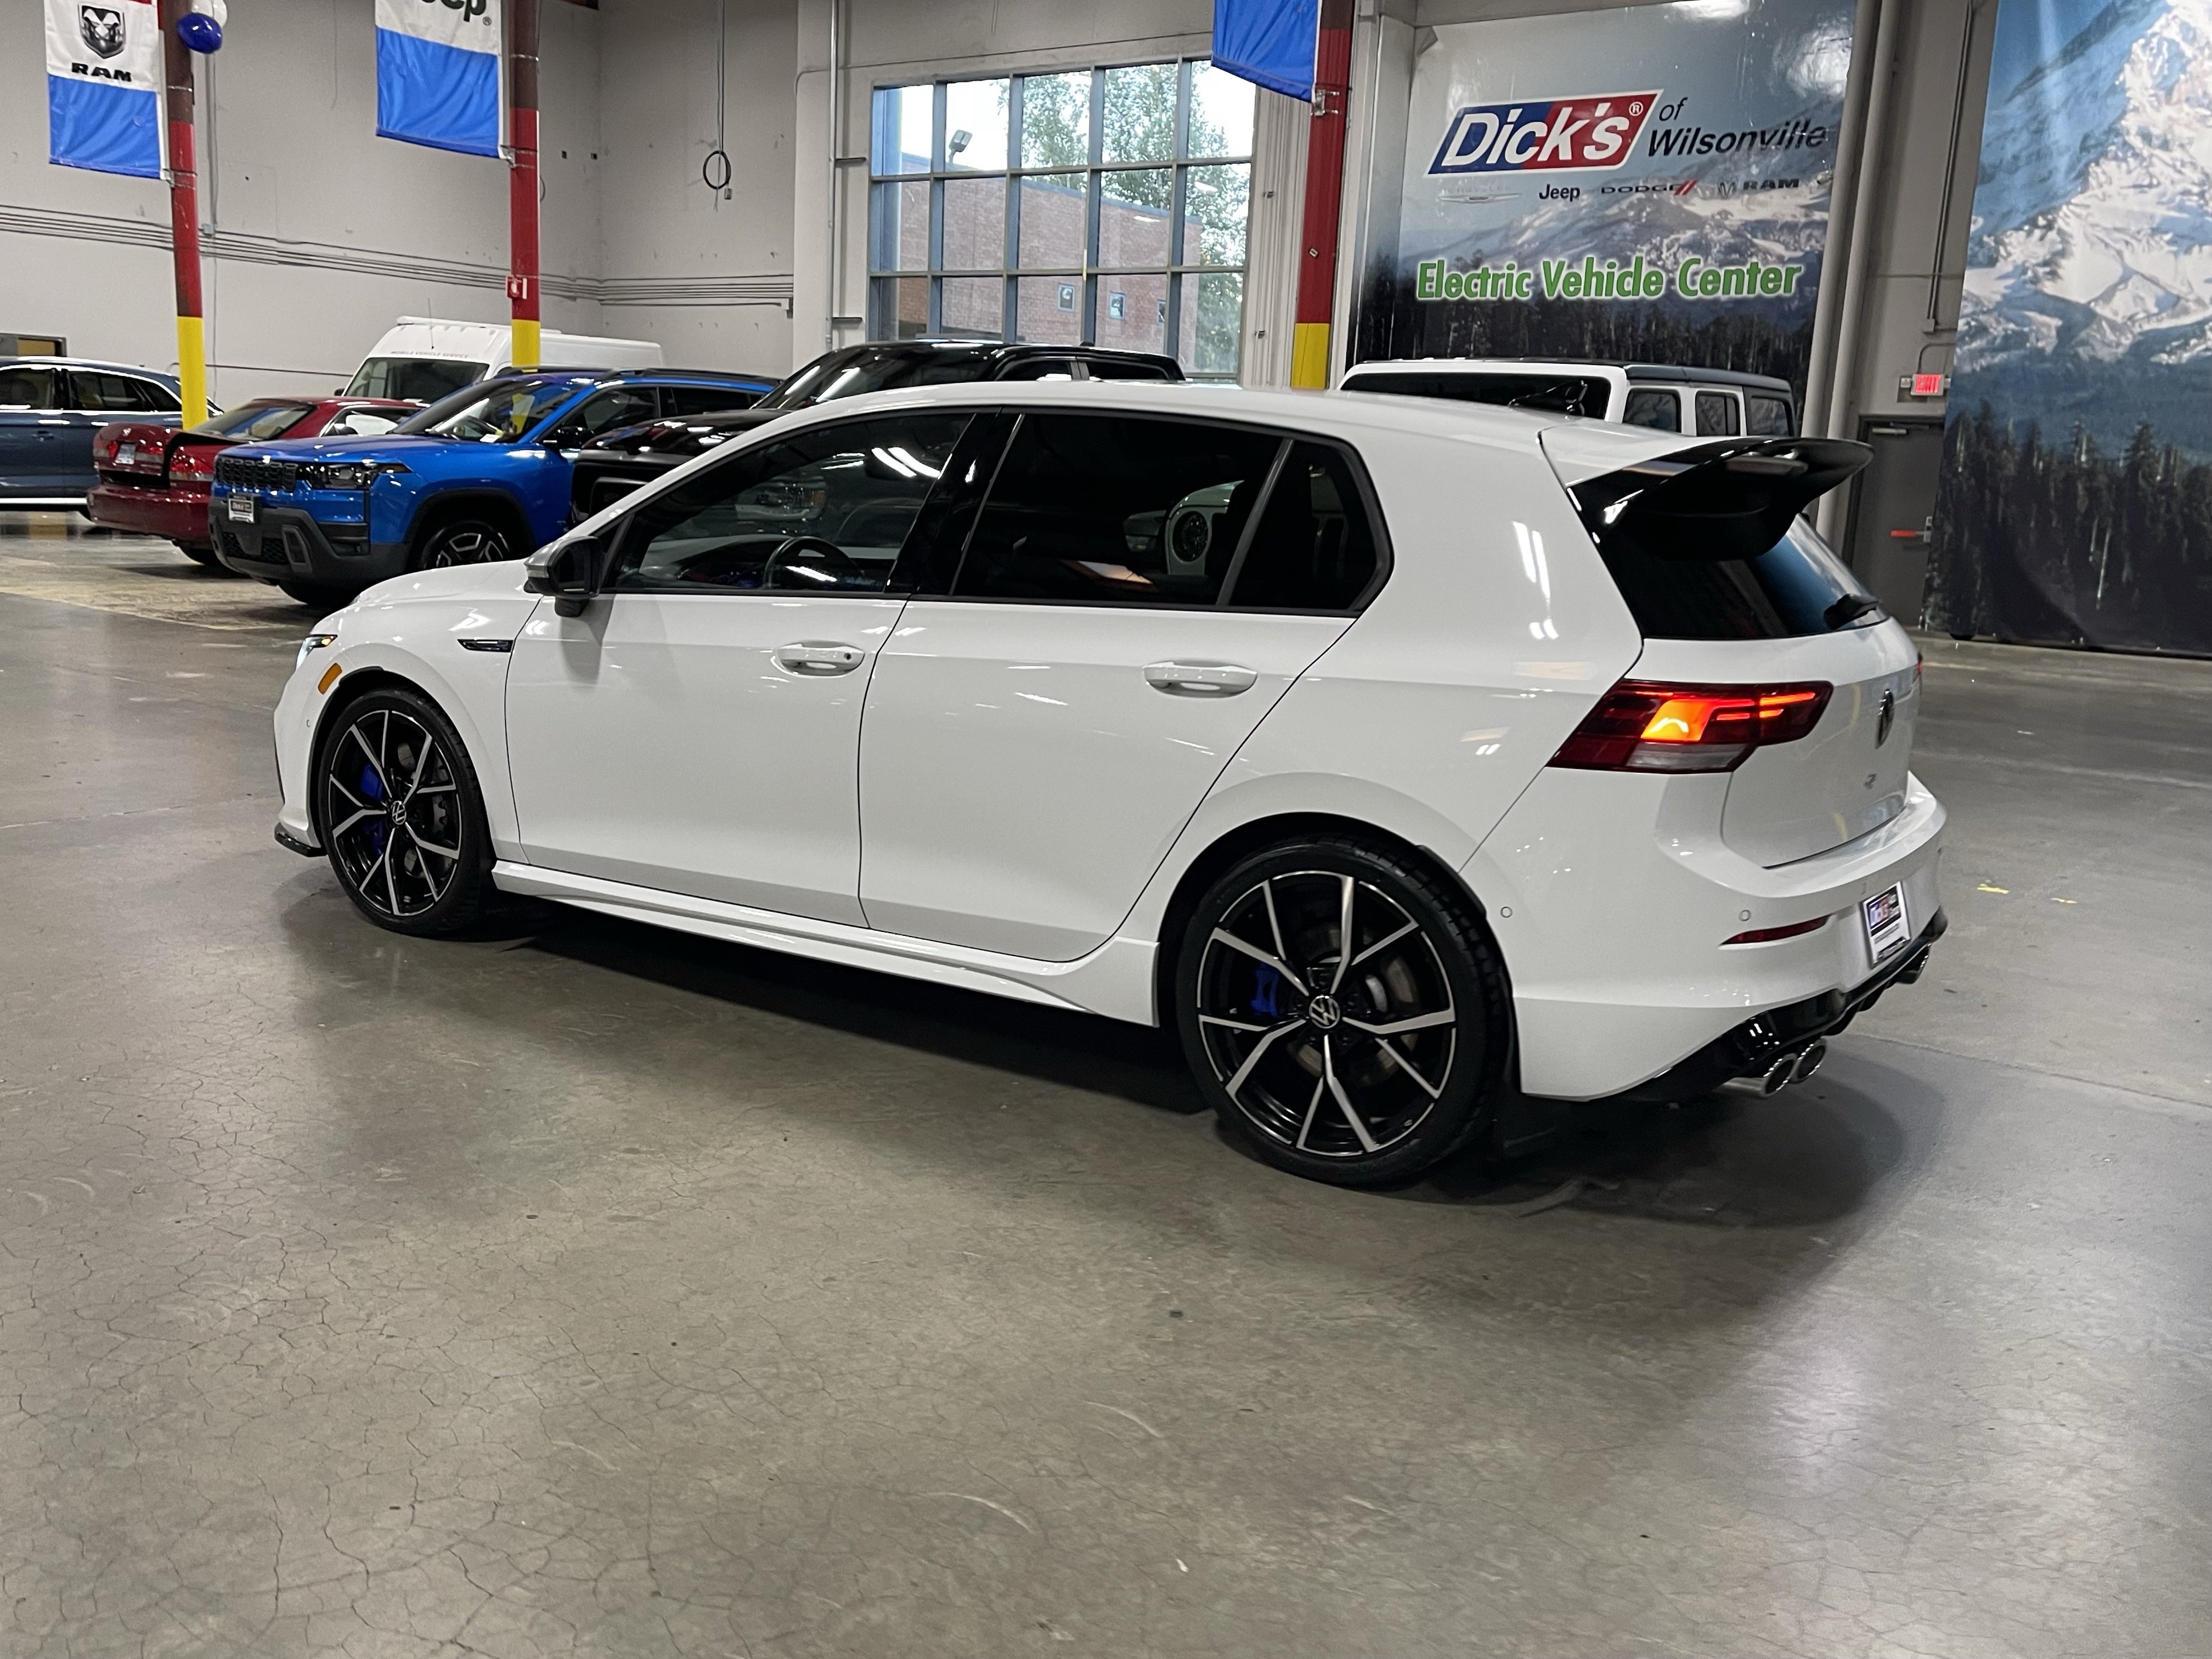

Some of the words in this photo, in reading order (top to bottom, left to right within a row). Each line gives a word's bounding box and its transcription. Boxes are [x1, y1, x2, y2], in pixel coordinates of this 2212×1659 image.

[71, 63, 132, 82] RAM
[1658, 97, 1688, 121] of
[1647, 118, 1827, 157] Wilsonville
[1538, 184, 1581, 202] Jeep
[1742, 178, 1800, 190] RAM
[1417, 259, 1532, 298] Electric
[1542, 256, 1664, 297] Vehicle
[1678, 257, 1802, 296] Center
[1915, 374, 1942, 393] EXIT
